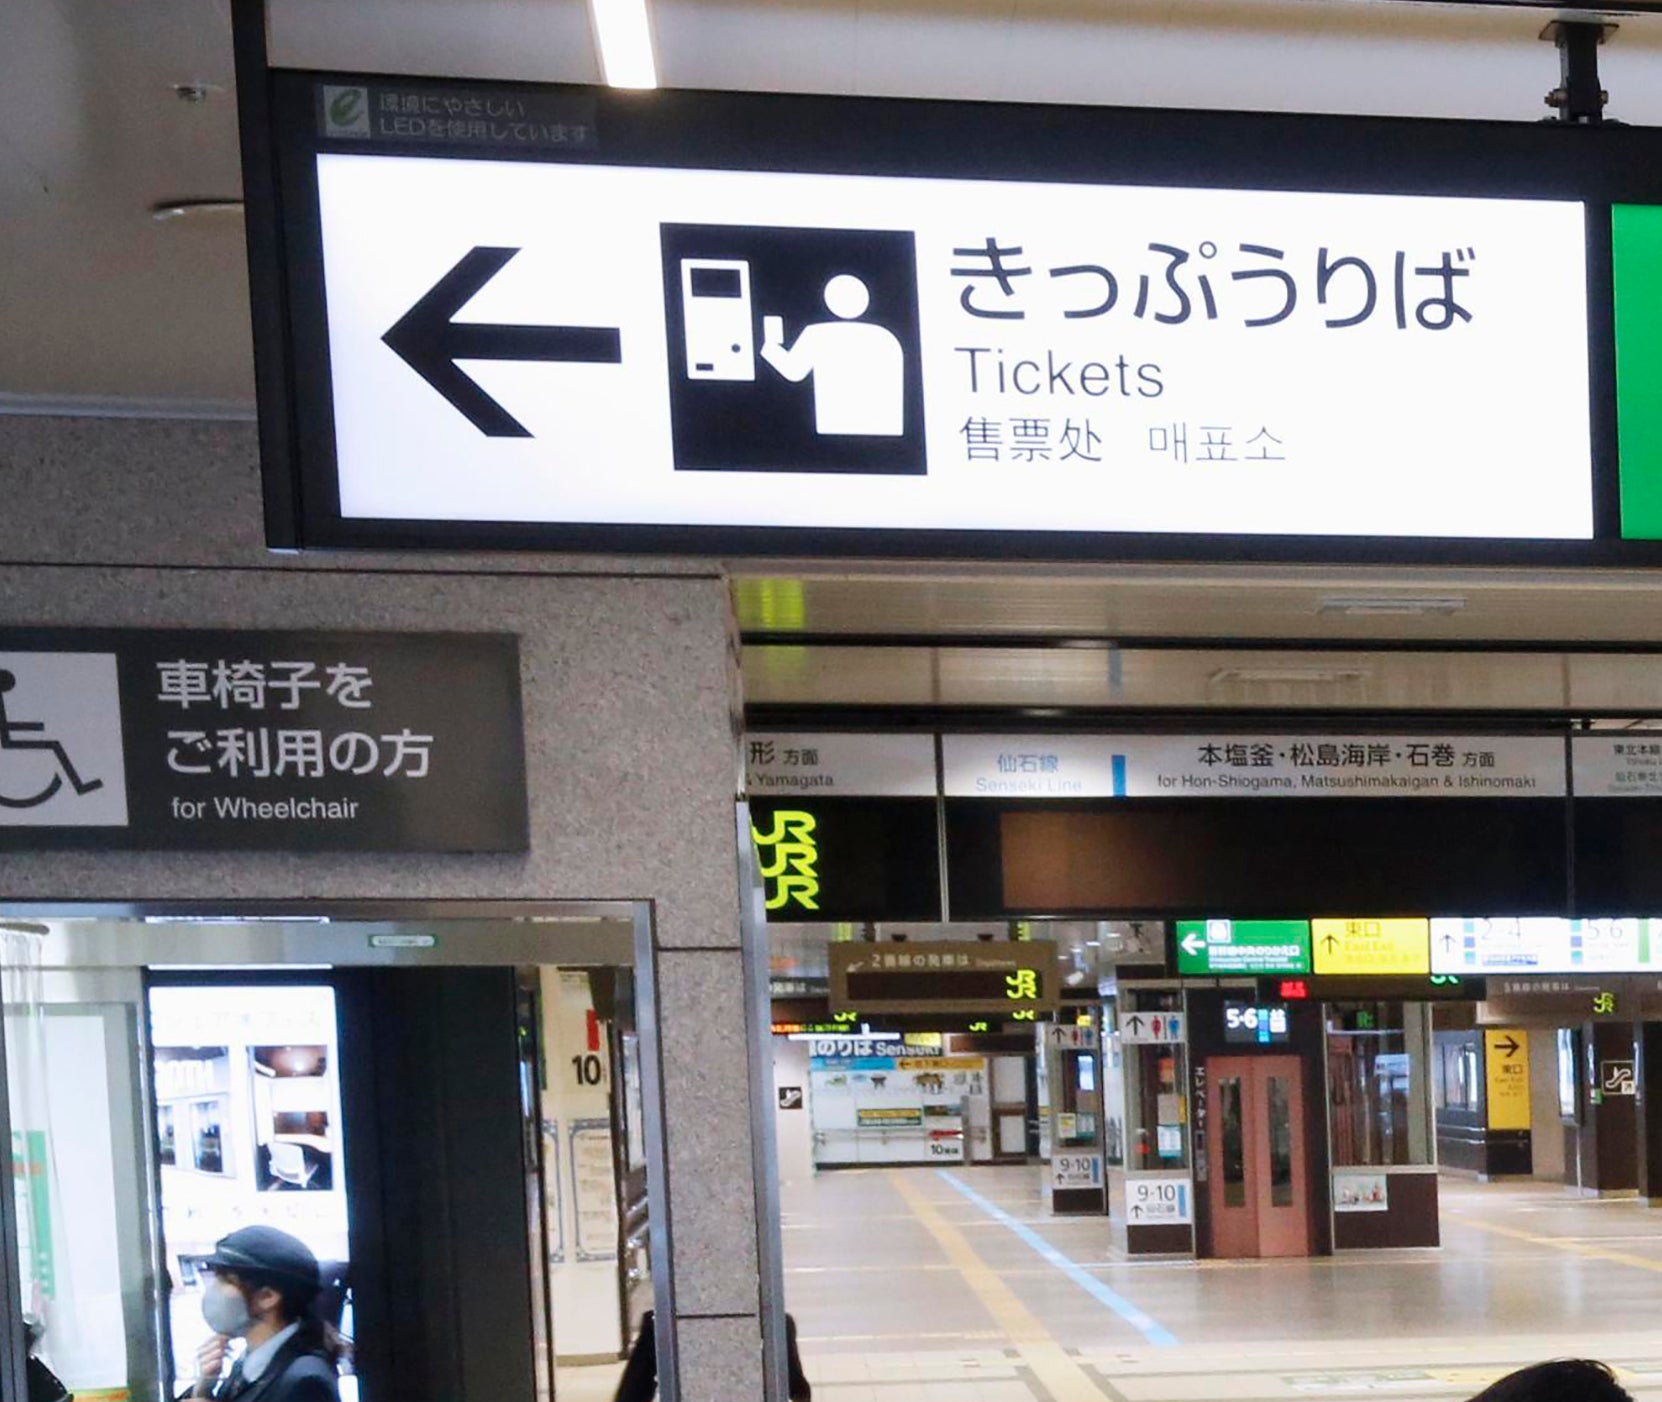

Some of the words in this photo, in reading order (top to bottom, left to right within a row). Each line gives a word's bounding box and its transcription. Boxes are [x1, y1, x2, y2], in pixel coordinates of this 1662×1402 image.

[380, 118, 588, 142] LEDを使用しています
[950, 237, 1476, 331] きっぷうりば
[954, 347, 1164, 398] Tickets
[960, 416, 1102, 462] 售票处
[1147, 418, 1287, 467] 매표소
[156, 660, 374, 711] 車椅子を
[166, 728, 434, 779] ご利用の方
[750, 741, 775, 765] 形
[783, 749, 819, 766] 方面
[997, 753, 1060, 775] 仙石線
[1198, 743, 1456, 768] 本塩釜・松島海岸・石巻
[1462, 751, 1496, 769] 方面
[757, 774, 835, 790] Yamagata
[975, 777, 1044, 793] Senseki
[1047, 777, 1083, 793] Line
[1157, 774, 1177, 790] for
[1181, 774, 1297, 792] Hon-Shiogama,
[1301, 774, 1440, 791] Matsushimakaigan
[1443, 775, 1454, 789] &
[1458, 774, 1538, 790] Ishinomaki
[172, 797, 206, 820] for
[213, 797, 360, 820] Wheelchair
[571, 1054, 601, 1086] 10
